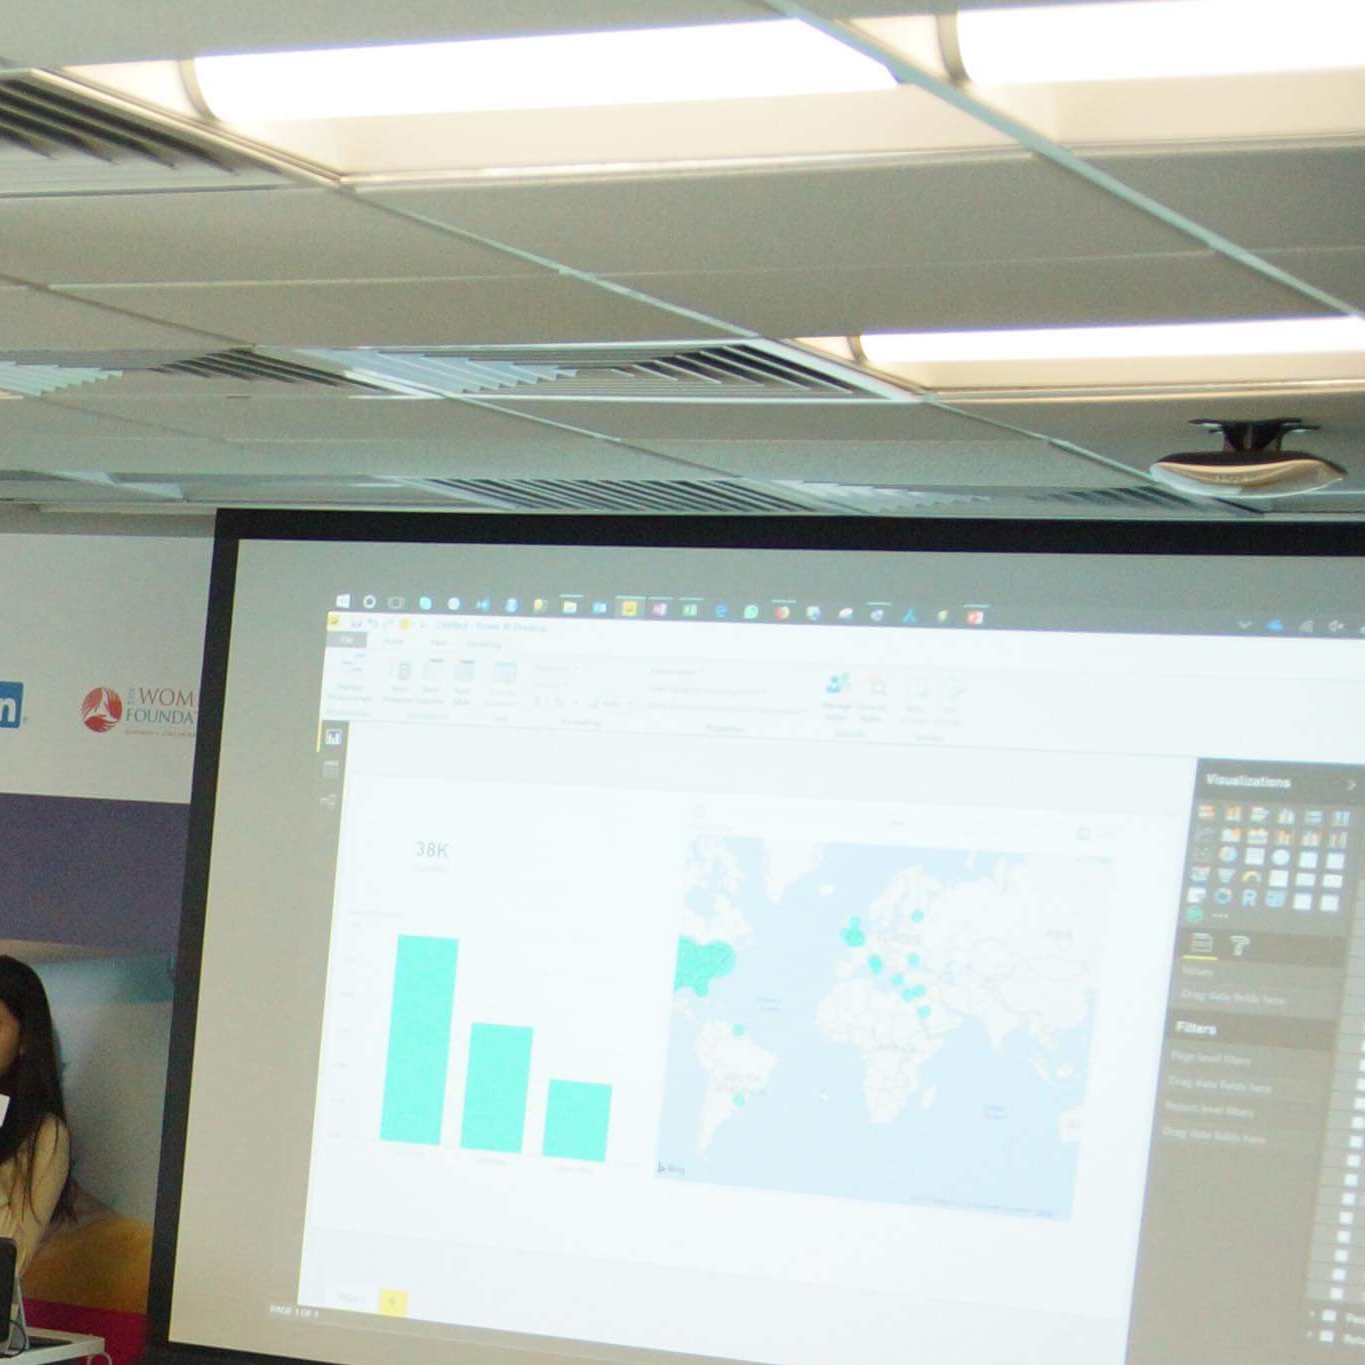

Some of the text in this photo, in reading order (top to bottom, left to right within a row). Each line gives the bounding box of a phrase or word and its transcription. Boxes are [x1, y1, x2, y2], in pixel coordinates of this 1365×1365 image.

[125, 708, 198, 725] FOUNDA
[1206, 773, 1292, 789] Visualizations
[1176, 1019, 1218, 1036] Filters
